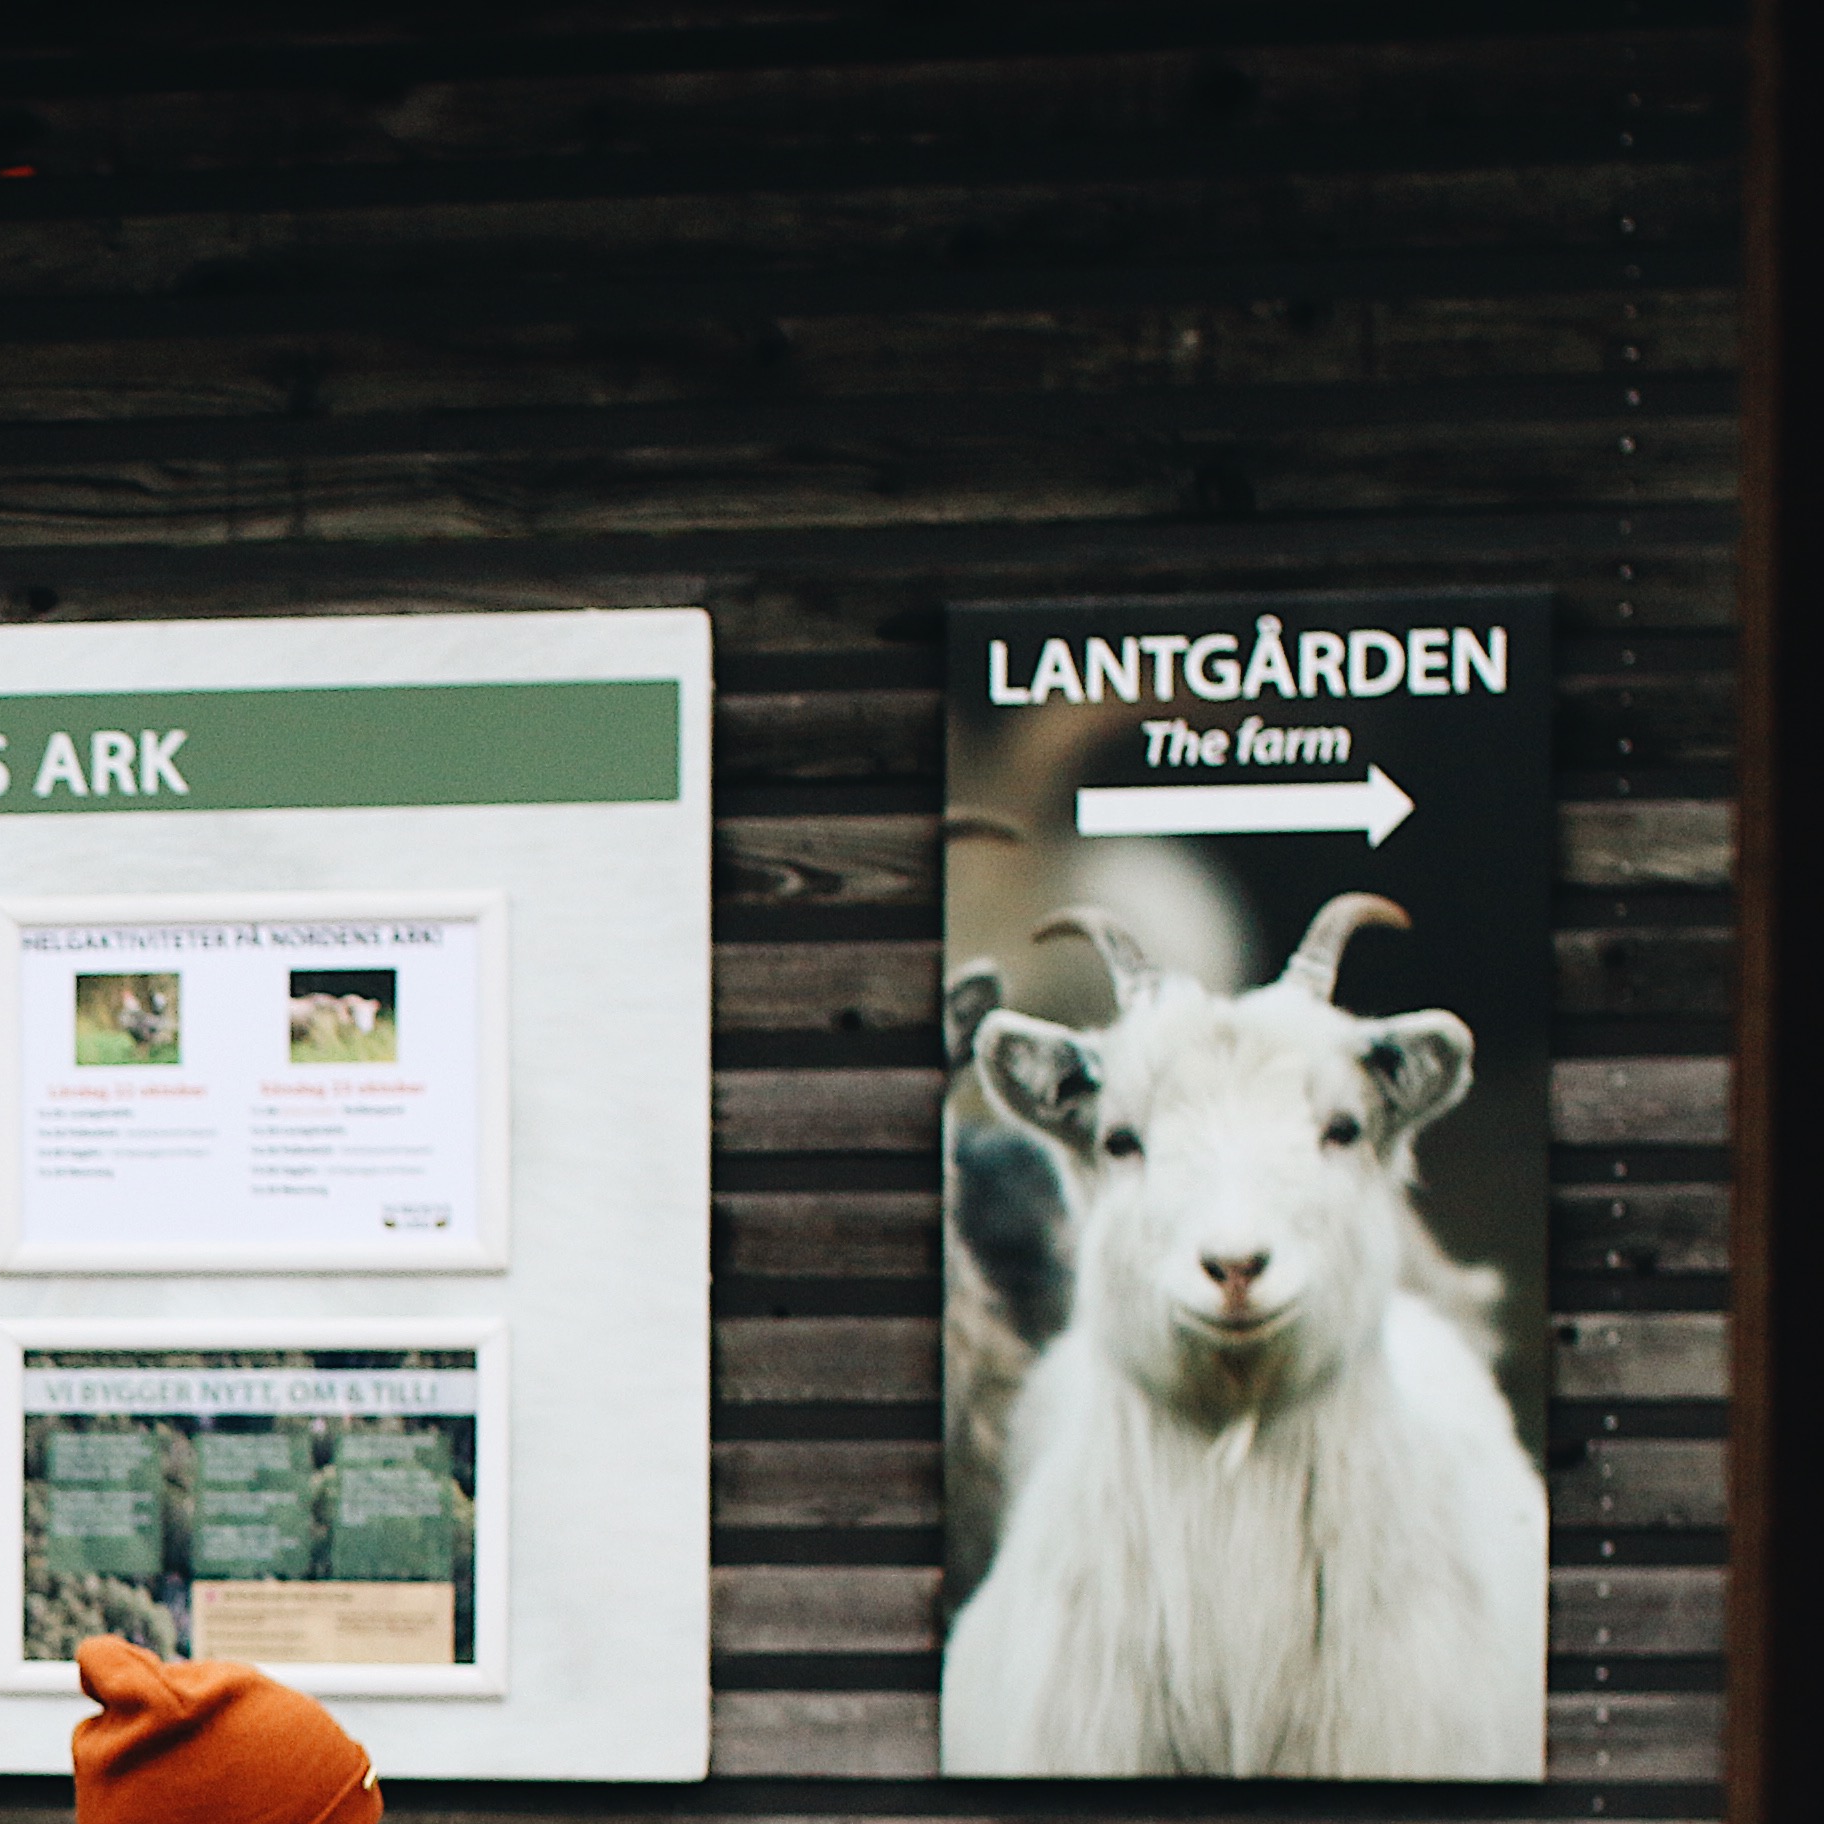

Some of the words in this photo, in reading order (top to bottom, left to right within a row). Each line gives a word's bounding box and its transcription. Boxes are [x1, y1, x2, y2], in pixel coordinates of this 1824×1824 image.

[988, 613, 1508, 706] LANTGÅRDEN
[32, 729, 191, 797] ARK
[1141, 718, 1229, 767] The
[1236, 715, 1351, 766] farm
[270, 924, 385, 948] NORDENS
[79, 1375, 193, 1403] BYGGER
[288, 1374, 338, 1402] OM
